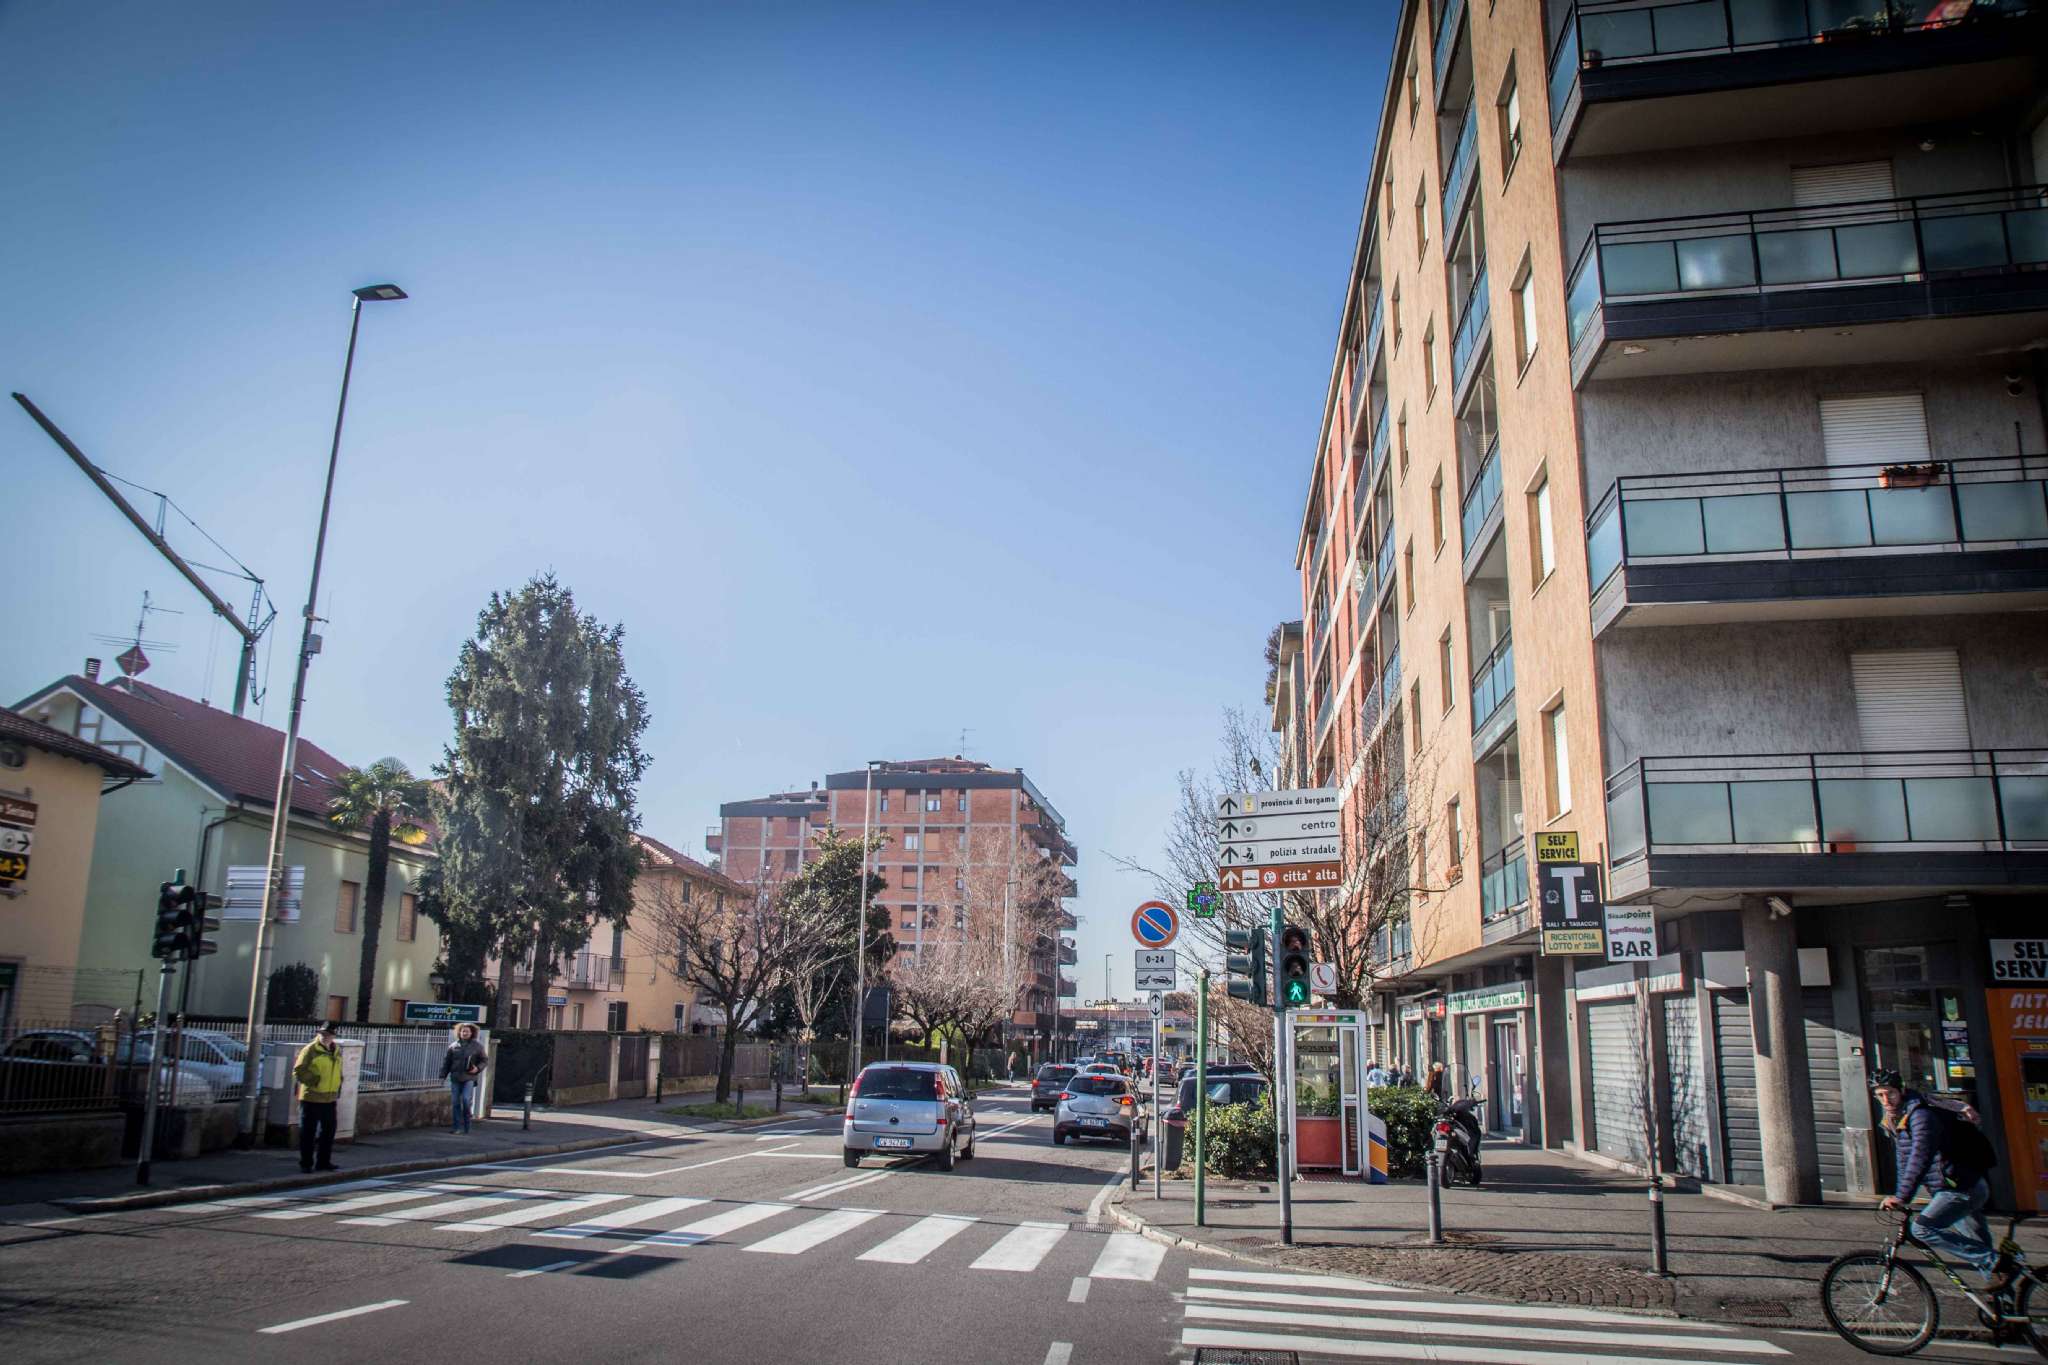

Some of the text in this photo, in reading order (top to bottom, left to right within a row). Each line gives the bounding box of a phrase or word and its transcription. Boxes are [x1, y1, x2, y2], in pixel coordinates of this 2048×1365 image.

[1261, 795, 1335, 809] provincia di bergamo
[1301, 820, 1336, 830] centro
[1547, 835, 1568, 846] SELF
[1270, 844, 1336, 858] polizia stradale
[1540, 847, 1576, 860] SERVICE
[1315, 869, 1337, 881] alta
[1551, 867, 1585, 920] T
[1568, 920, 1599, 928] TABACCHI
[1550, 932, 1596, 941] RICEVITORIA
[1548, 942, 1573, 951] LOTTO
[1611, 940, 1653, 957] BAR
[1145, 955, 1165, 964] 0-24
